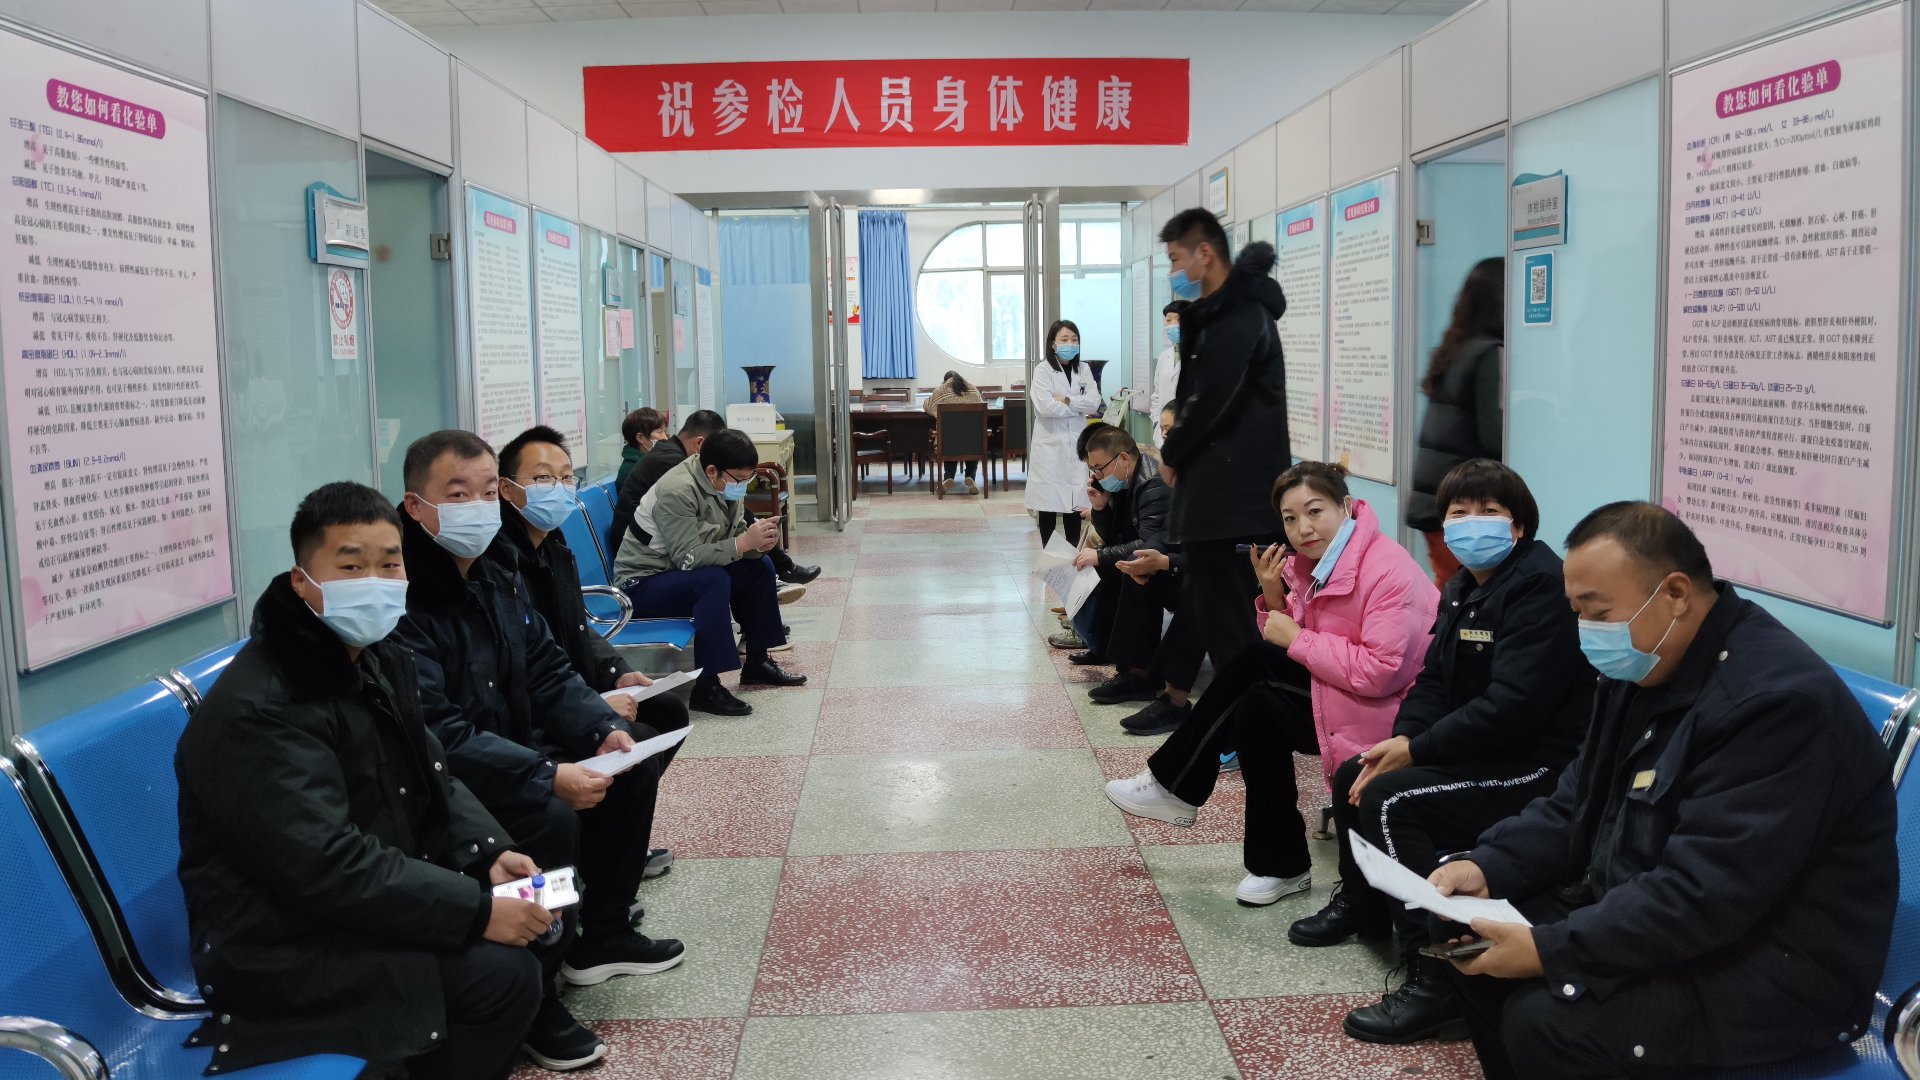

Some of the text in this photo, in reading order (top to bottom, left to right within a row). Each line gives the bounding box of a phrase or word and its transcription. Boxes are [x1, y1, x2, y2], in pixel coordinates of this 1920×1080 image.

[56, 84, 158, 133] 教您如何看化验单
[657, 75, 1133, 138] 祝参检人员身体健康
[1722, 67, 1829, 115] 教您如何看化验单
